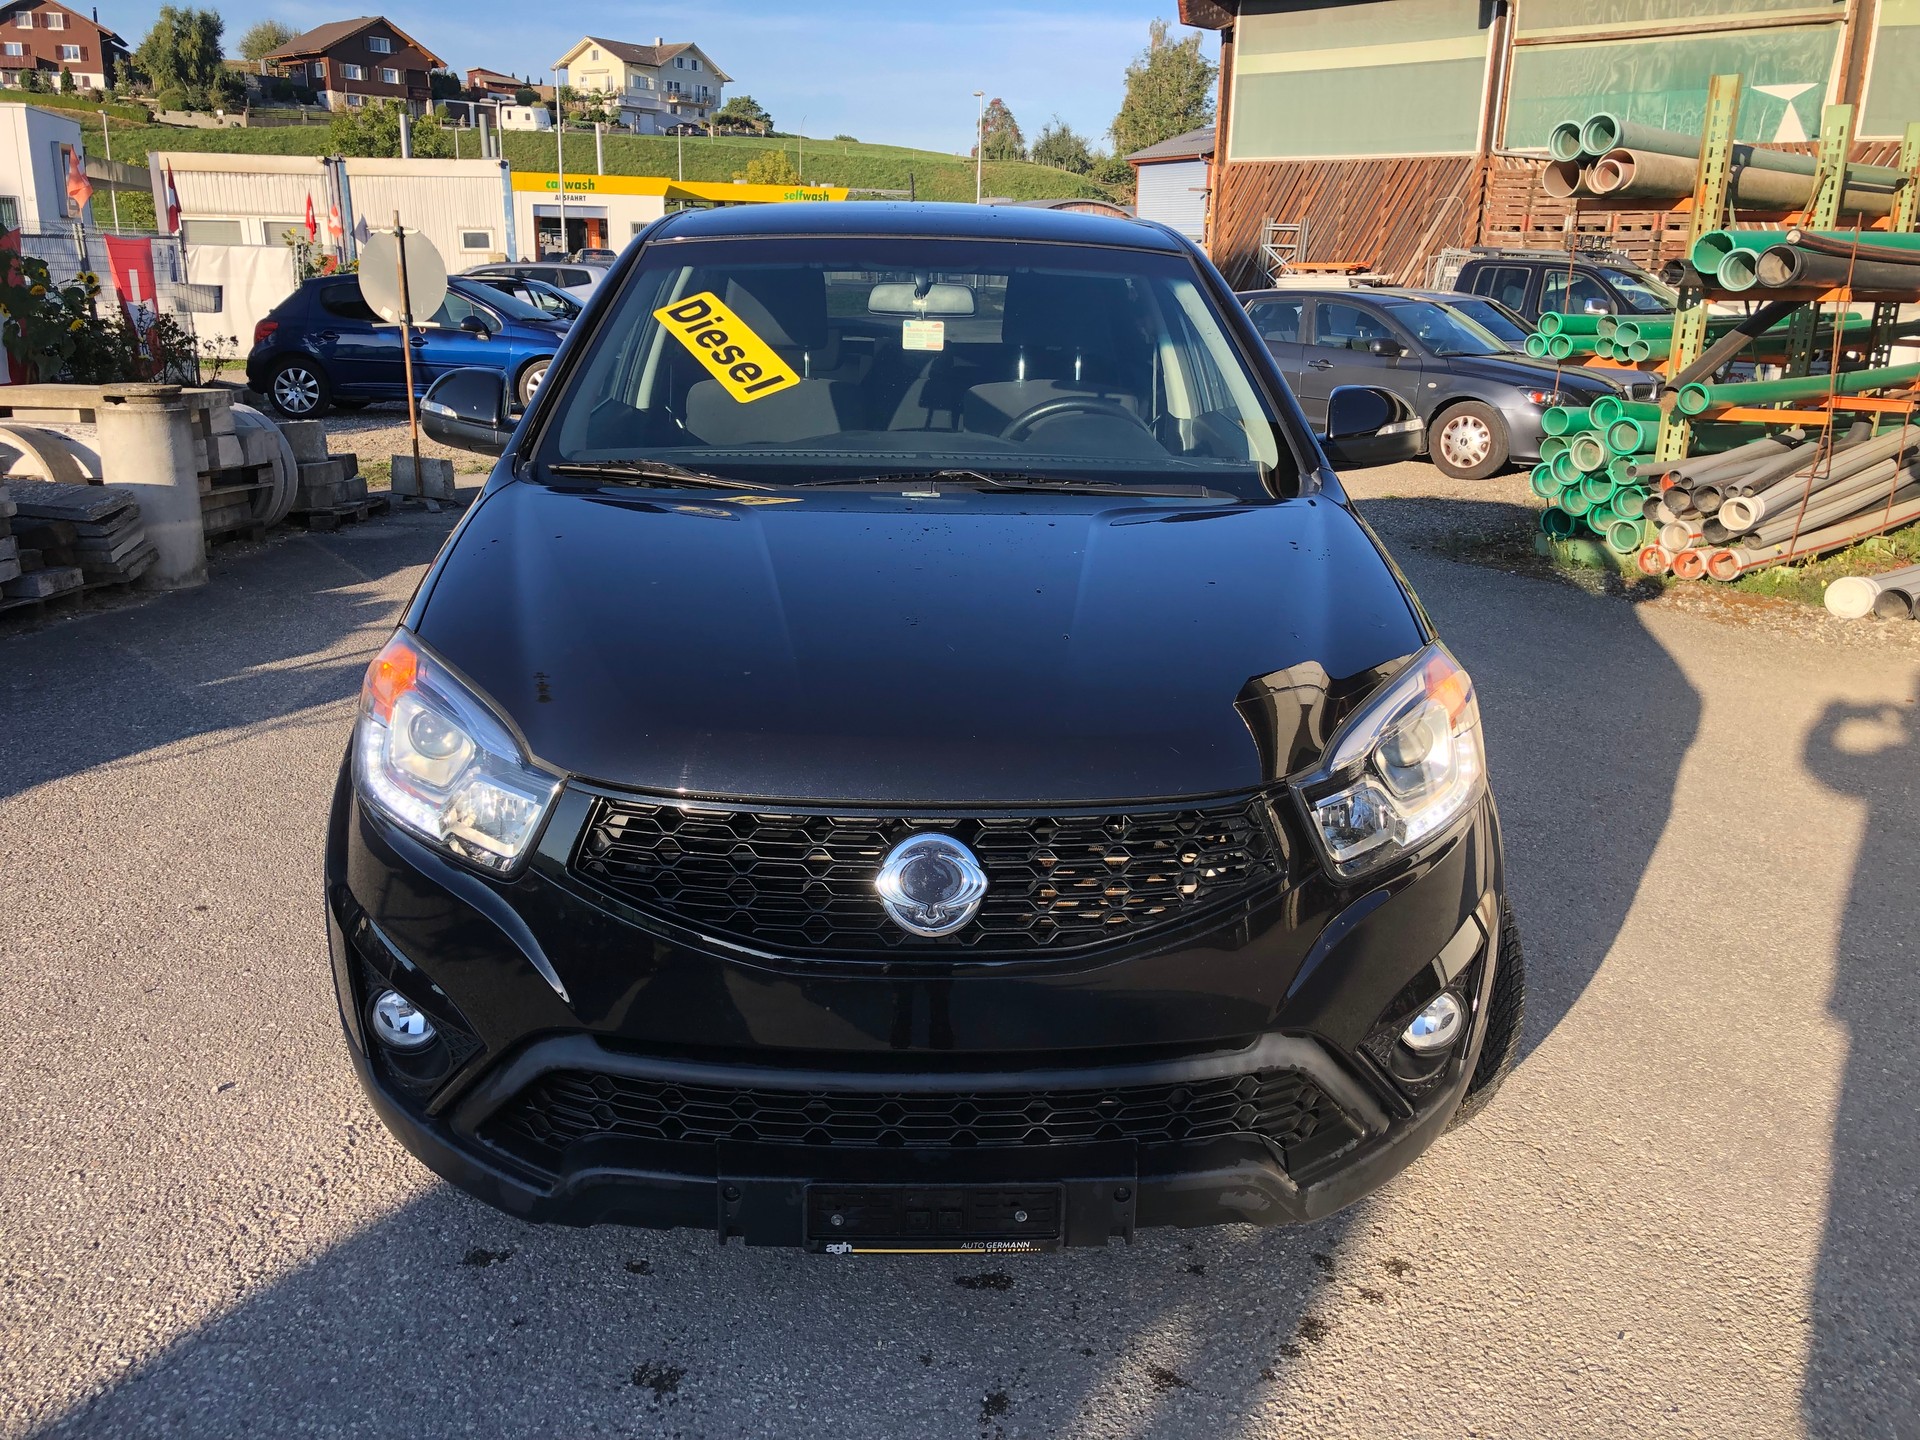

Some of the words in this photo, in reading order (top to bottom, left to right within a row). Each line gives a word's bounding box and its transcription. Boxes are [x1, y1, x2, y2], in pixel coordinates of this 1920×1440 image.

[545, 178, 595, 190] cawash
[783, 189, 830, 202] selfwash
[666, 298, 786, 395] Diesel
[825, 1241, 853, 1255] agh
[960, 1241, 985, 1249] AUTO
[985, 1241, 1031, 1249] GERMANN
